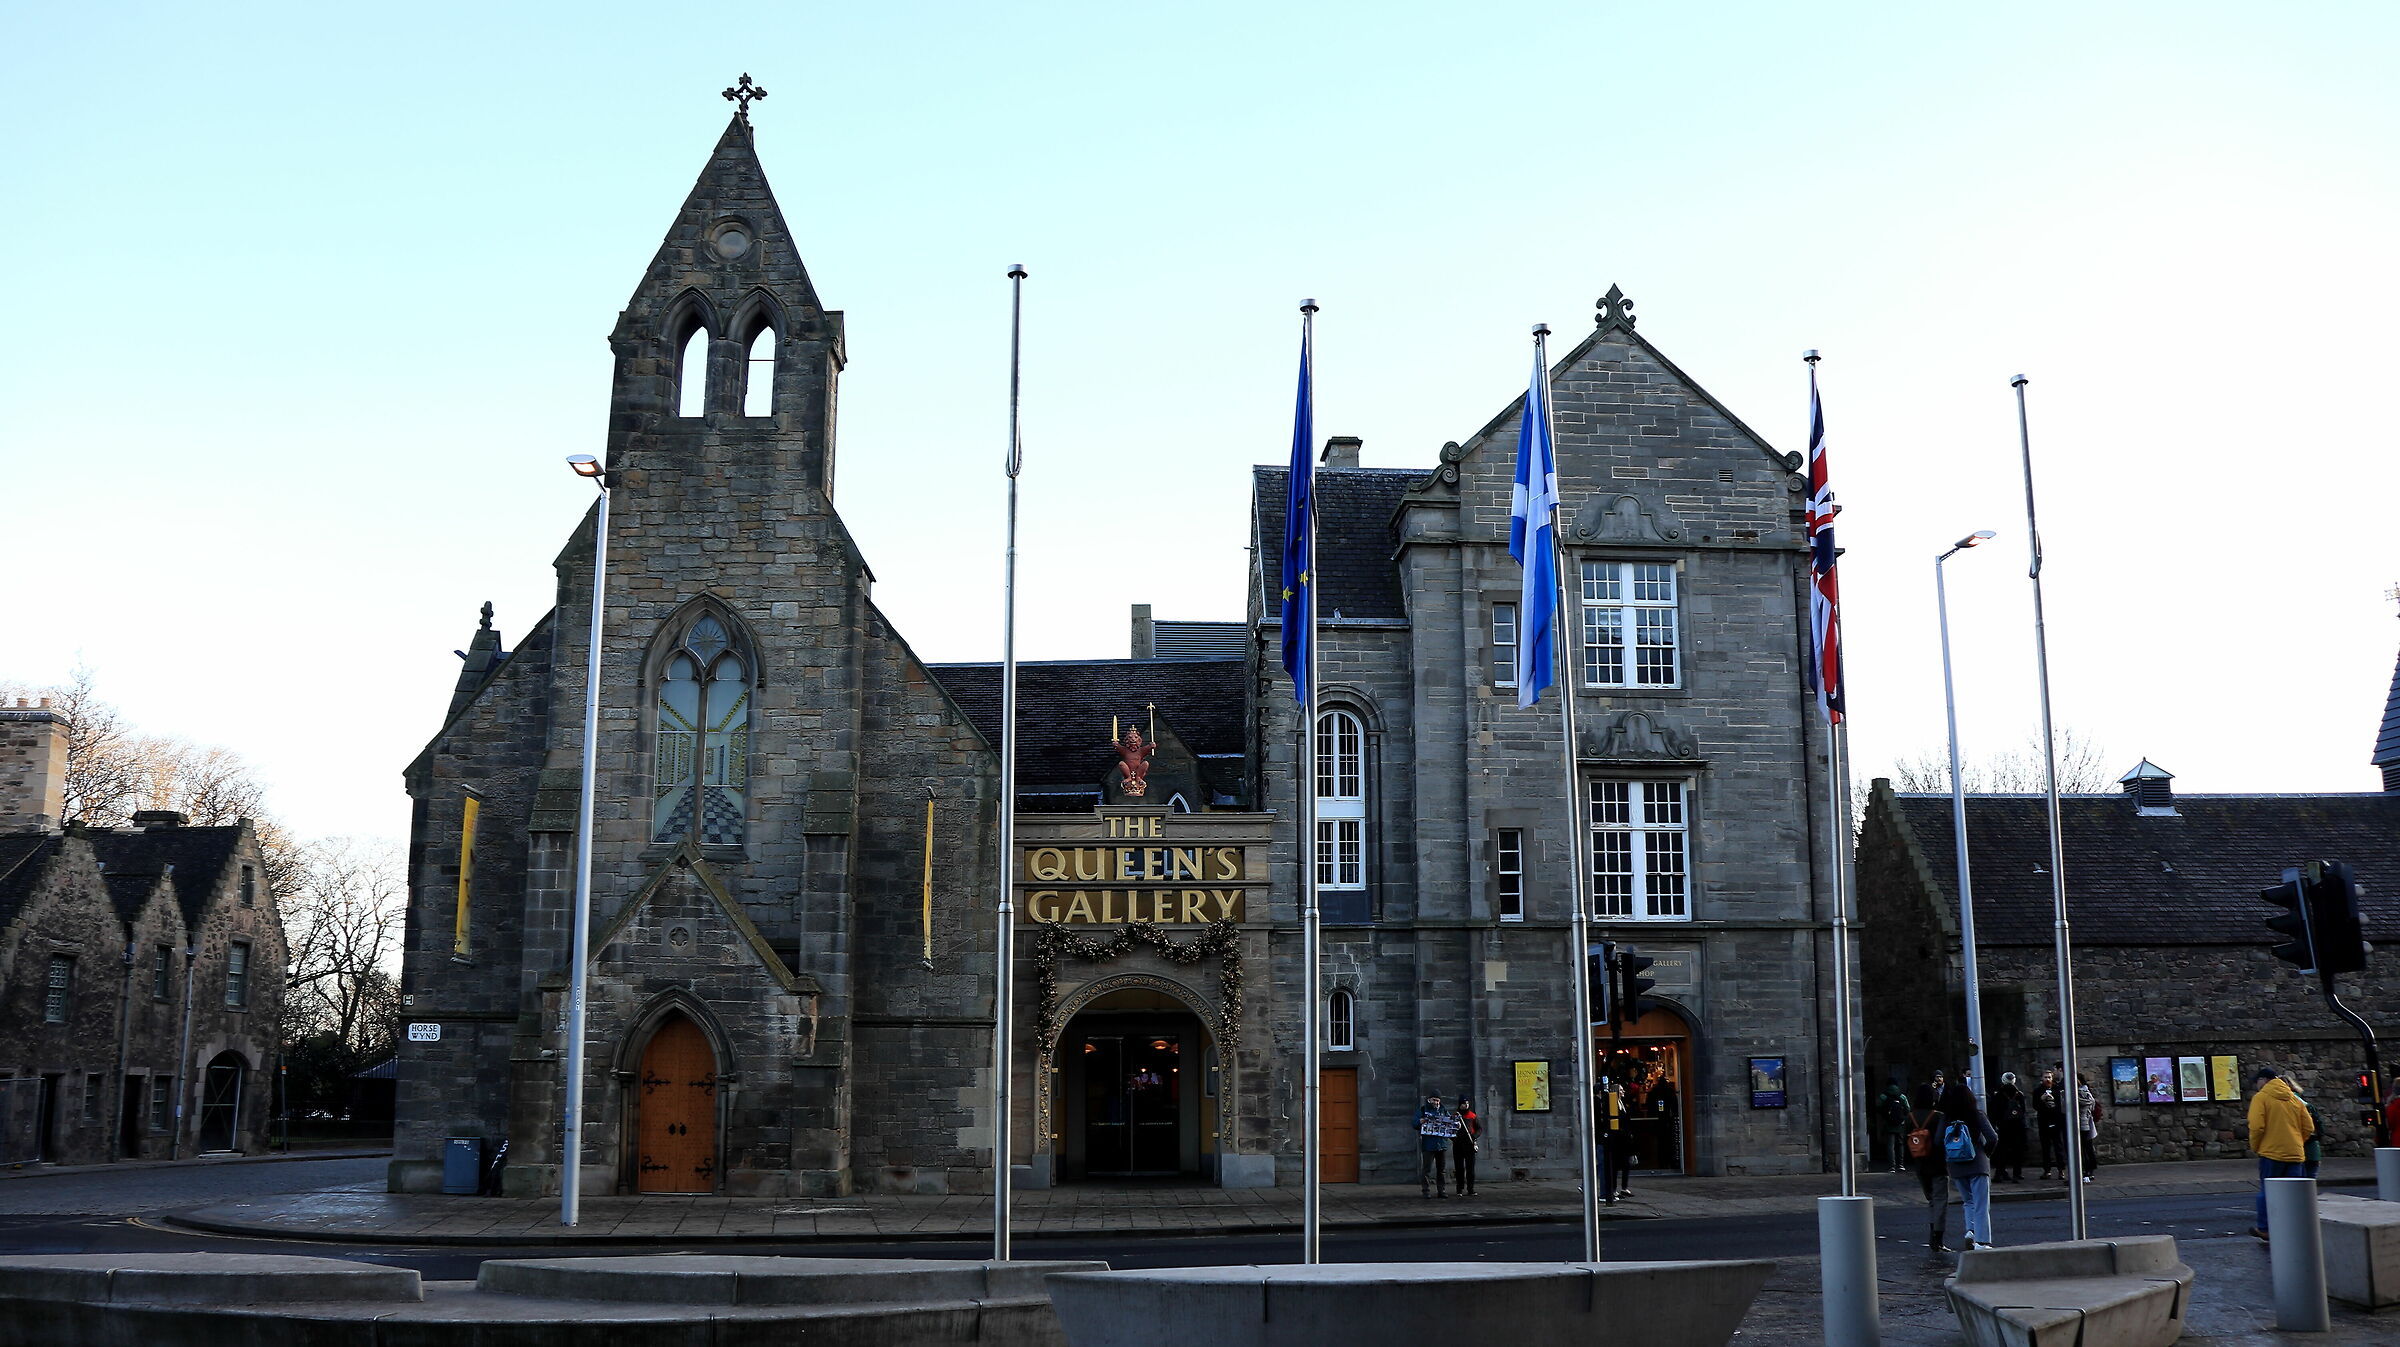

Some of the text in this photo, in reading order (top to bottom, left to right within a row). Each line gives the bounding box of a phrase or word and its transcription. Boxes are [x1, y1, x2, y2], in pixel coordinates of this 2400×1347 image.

[1104, 816, 1163, 838] THE
[1030, 847, 1238, 881] QUEEN'S
[1028, 889, 1242, 924] GALLERY
[411, 1024, 438, 1032] HORSE
[411, 1032, 438, 1040] WYND
